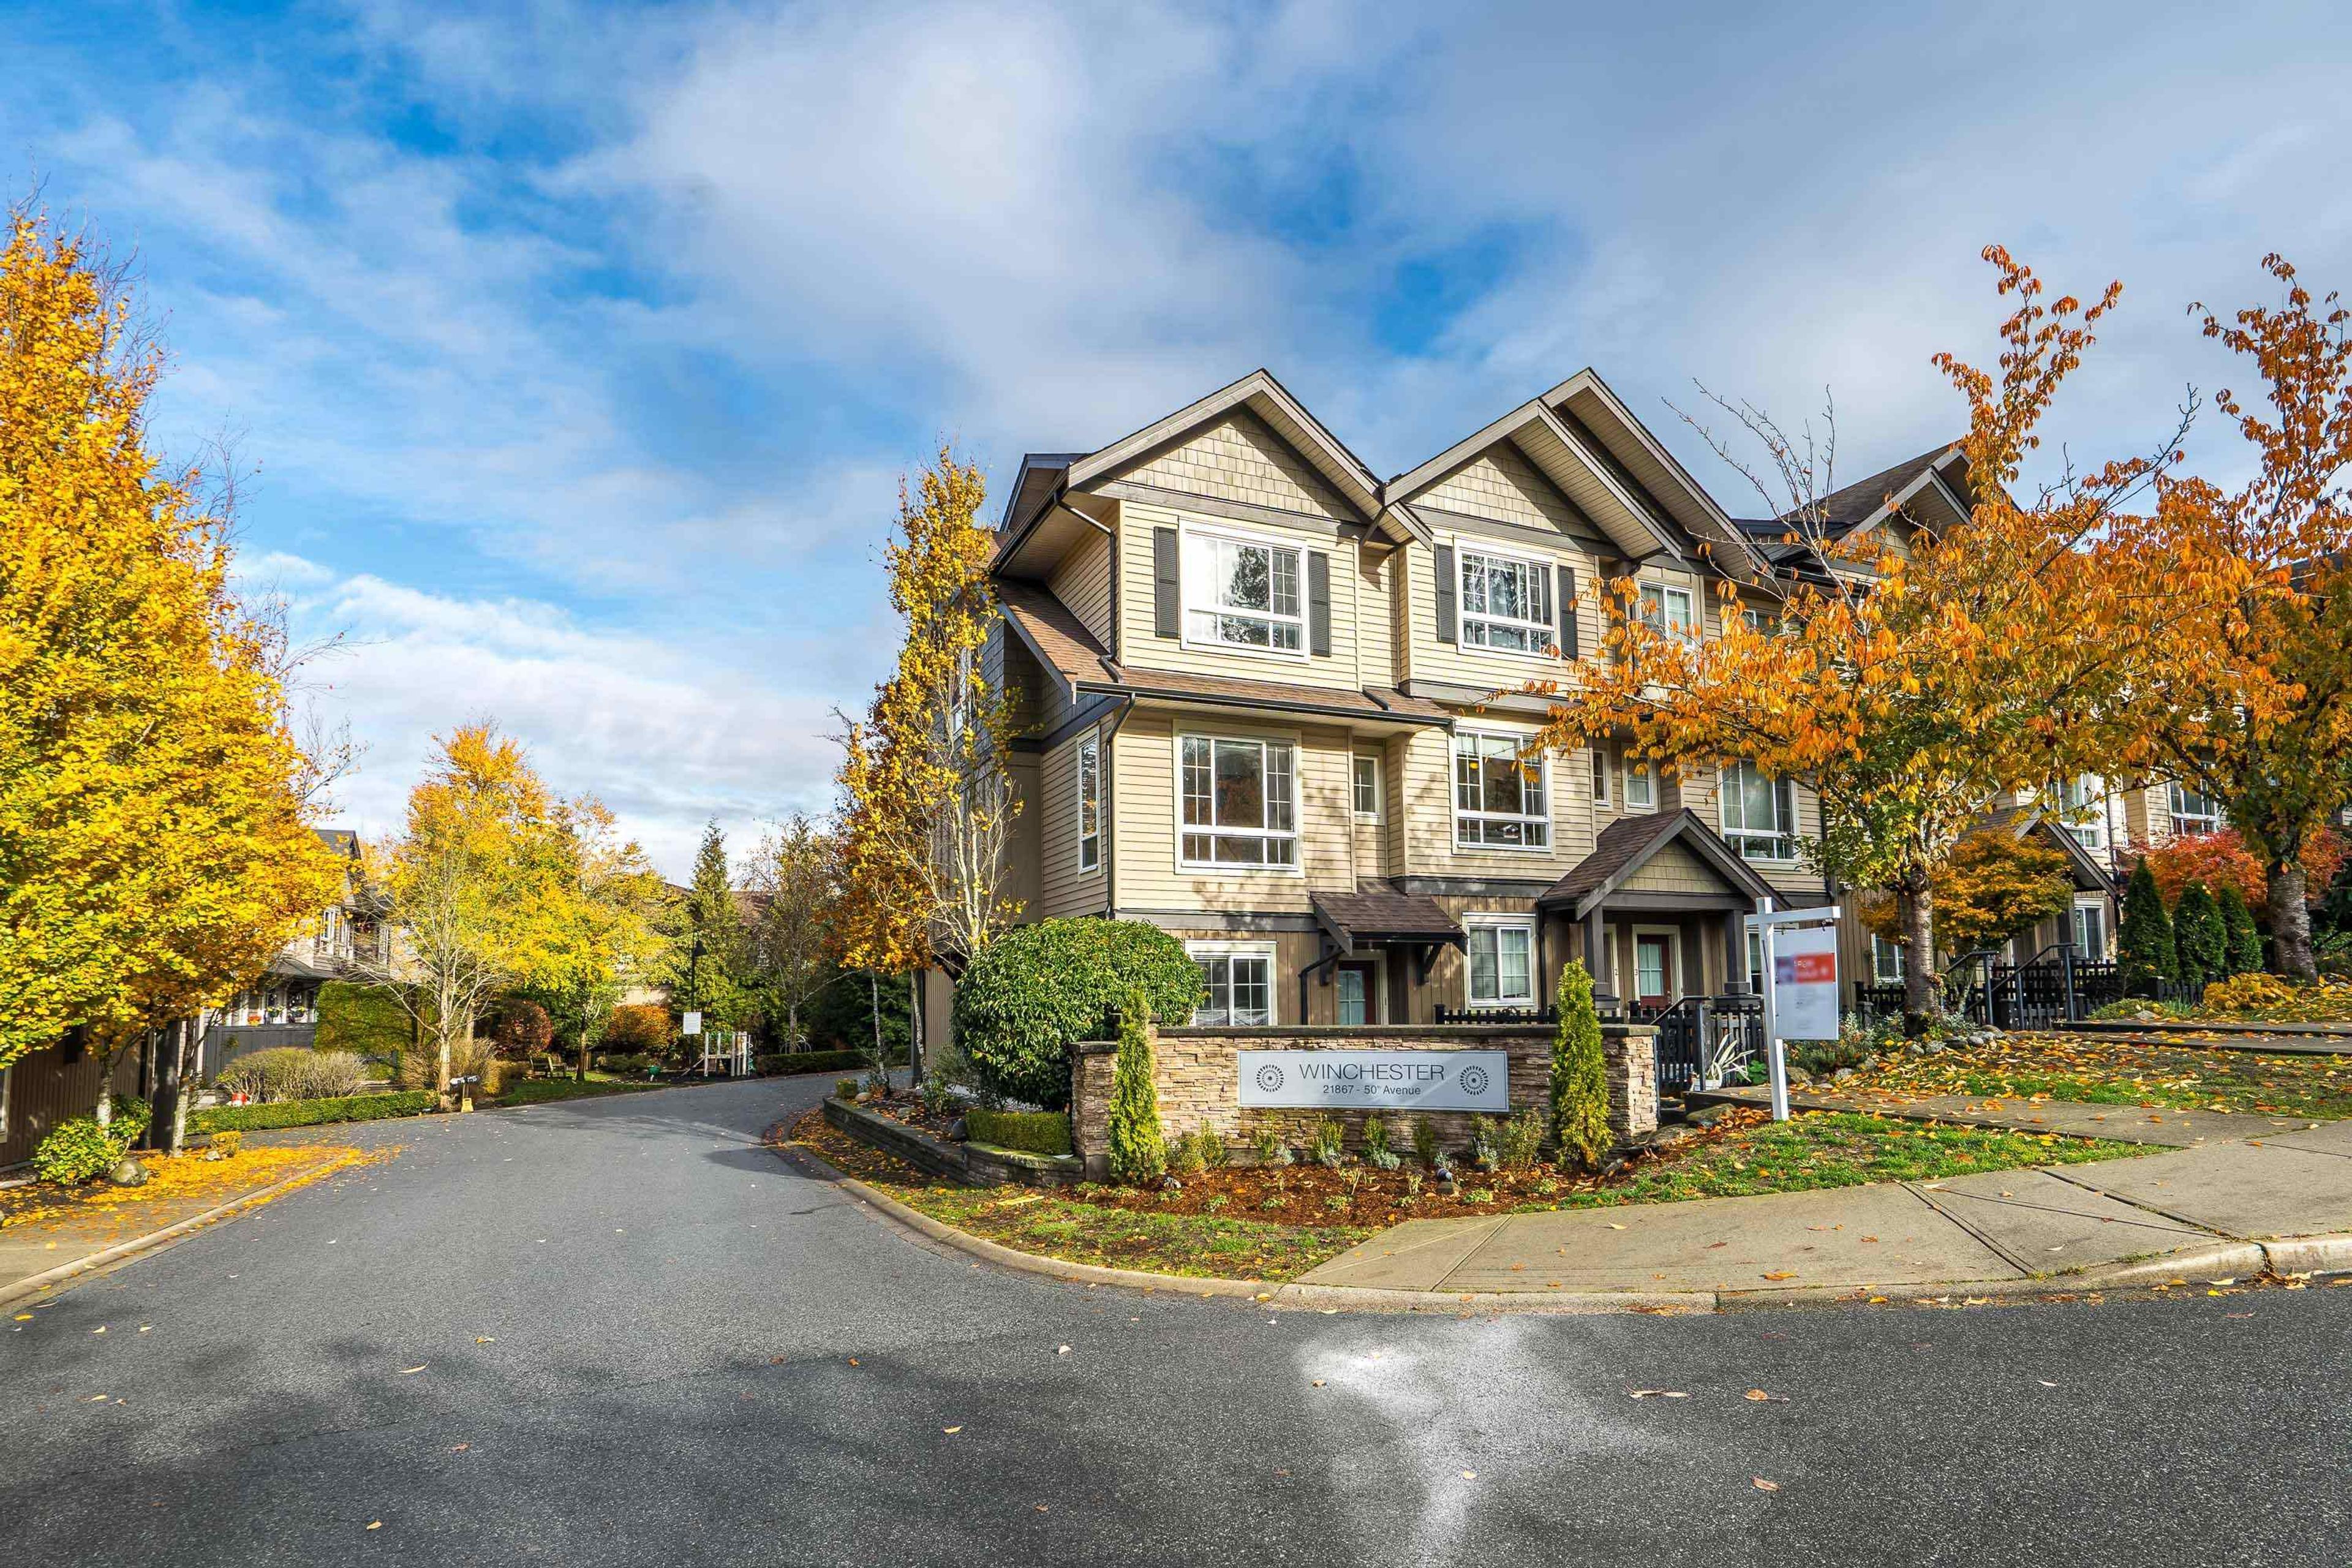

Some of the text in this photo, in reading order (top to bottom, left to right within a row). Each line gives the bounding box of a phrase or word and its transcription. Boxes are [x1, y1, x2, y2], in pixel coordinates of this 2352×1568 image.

[1298, 1063, 1444, 1080] WINCHESTER
[1323, 1085, 1354, 1095] 21867
[1383, 1085, 1421, 1095] Avenue
